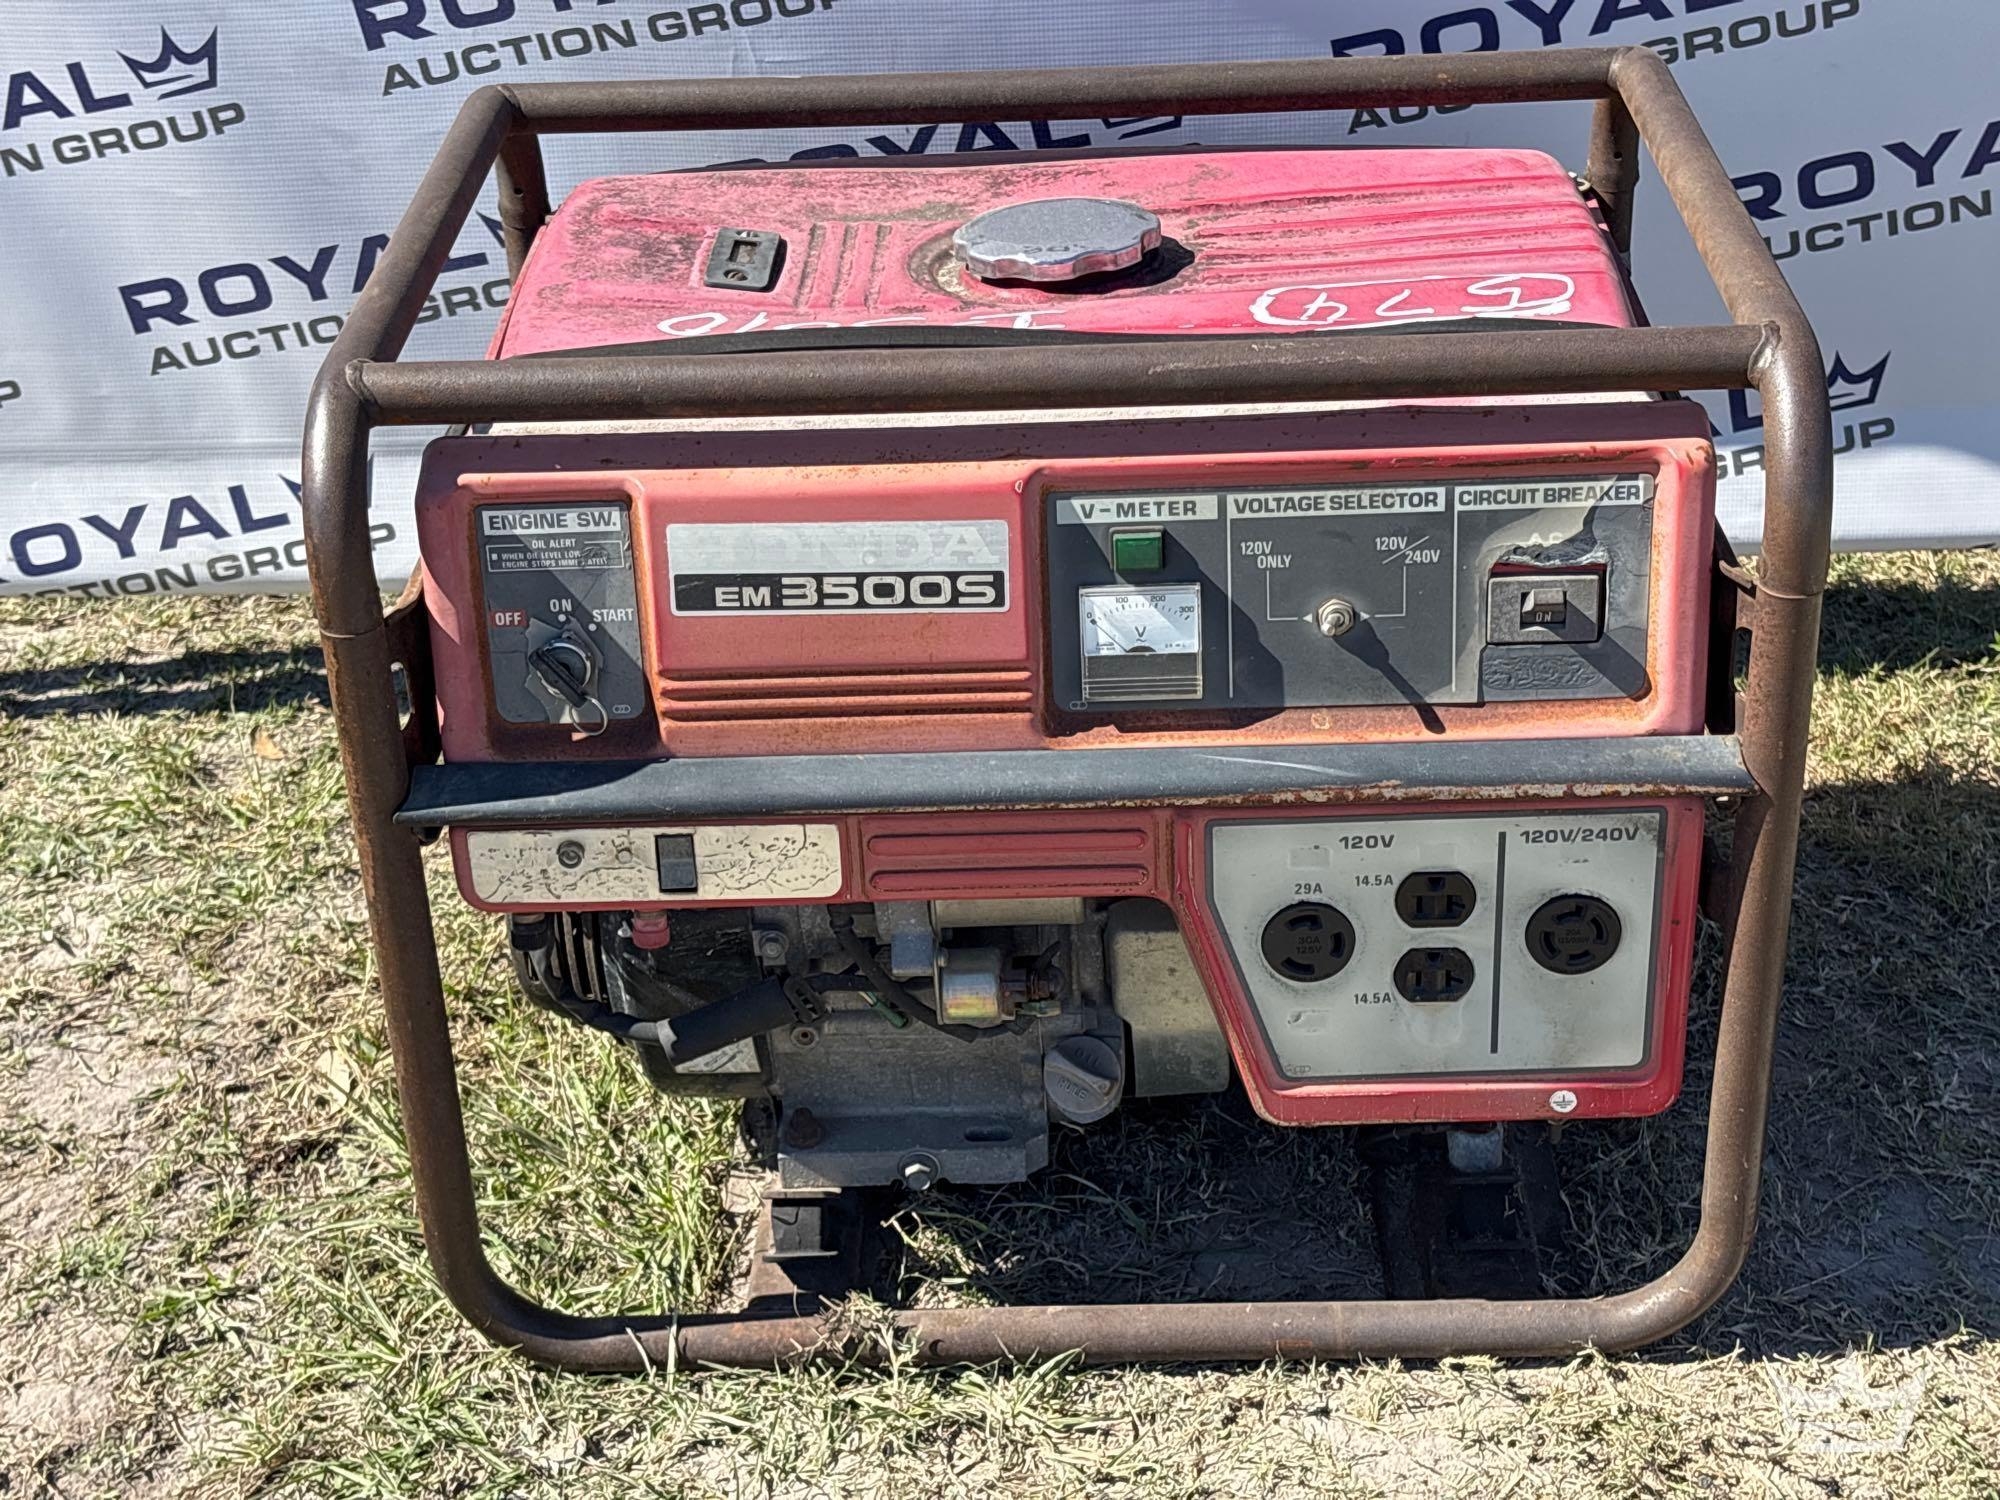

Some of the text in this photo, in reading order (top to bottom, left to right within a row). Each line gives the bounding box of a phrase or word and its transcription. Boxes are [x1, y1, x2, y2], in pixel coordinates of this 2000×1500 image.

[1641, 0, 1860, 65] GROUP
[382, 19, 638, 96] AUCTION
[52, 102, 245, 164] GROUP
[1764, 189, 1992, 260] UCTION
[150, 314, 350, 376] AUCTIO
[1233, 491, 1439, 514] VOLTAGE SELECTOR
[1458, 485, 1641, 506] CIRCUIT BREAKER
[488, 511, 617, 530] ENGINE SW.
[0, 484, 290, 583] OYAL
[531, 538, 576, 549] OIL ALERT
[1240, 541, 1272, 555] 120V
[501, 552, 524, 561] WHEN
[526, 552, 538, 560] OIL
[541, 551, 563, 560] LEVEL
[502, 558, 528, 569] ENGINE
[532, 558, 556, 568] STOPS
[1257, 554, 1292, 569] ONLY
[1404, 549, 1440, 564] 240V
[715, 574, 996, 608] EM 3500S
[550, 598, 572, 613] ON
[1115, 596, 1128, 604] 100
[494, 612, 522, 626] OFF
[592, 608, 634, 622] START
[1535, 611, 1552, 622] ON
[1134, 626, 1147, 638] V
[1339, 834, 1395, 850] 120V
[1519, 827, 1640, 845] 120V/240V
[1354, 874, 1394, 887] 14.5A
[1294, 883, 1323, 895] 29A
[1297, 935, 1321, 945] 30A
[1296, 945, 1322, 955] 125V
[1353, 992, 1392, 1005] 14.5A
